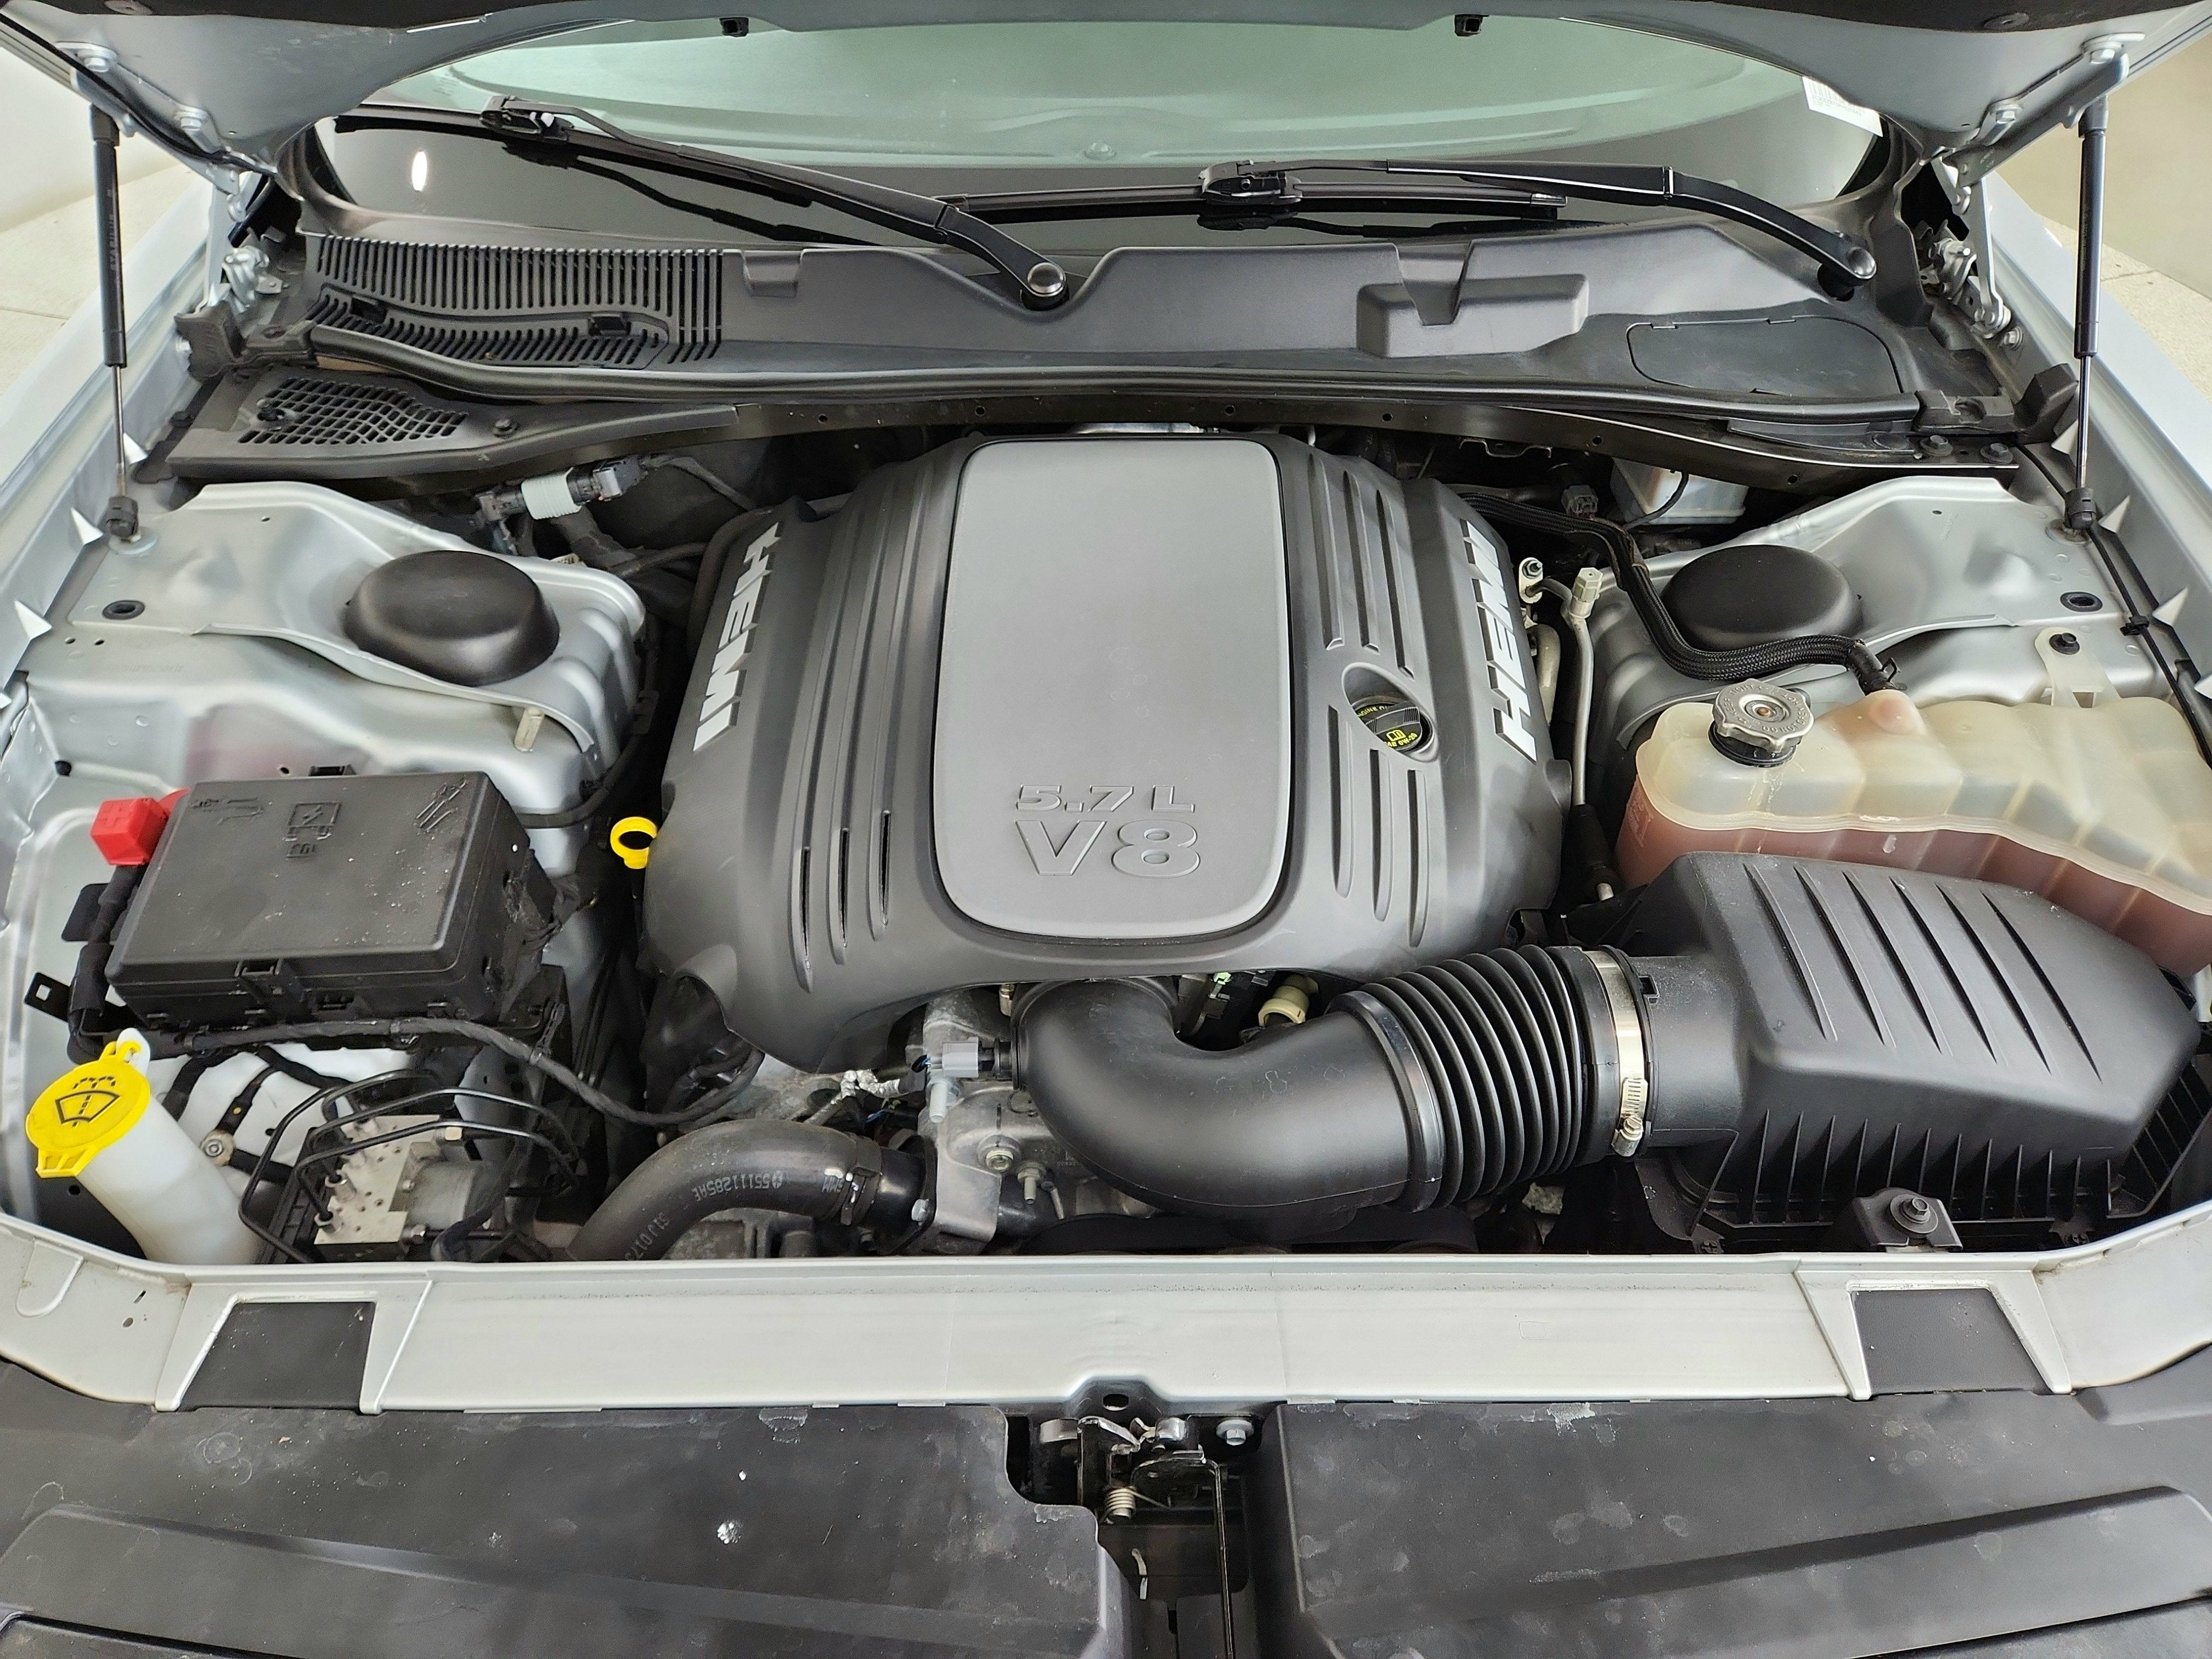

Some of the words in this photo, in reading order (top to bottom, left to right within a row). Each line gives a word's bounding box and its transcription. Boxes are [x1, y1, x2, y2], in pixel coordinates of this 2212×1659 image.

[693, 522, 780, 752] HEMI
[1460, 518, 1537, 765] HEMI
[1727, 685, 1754, 696] TIGHT
[1780, 693, 1803, 707] HOT
[1357, 707, 1379, 717] NGINE
[1796, 707, 1808, 725] OPEN
[1779, 723, 1800, 733] NOT
[1397, 732, 1418, 746] 0W-20
[1014, 820, 1201, 878] V8
[691, 1173, 771, 1202] 55111285AE
